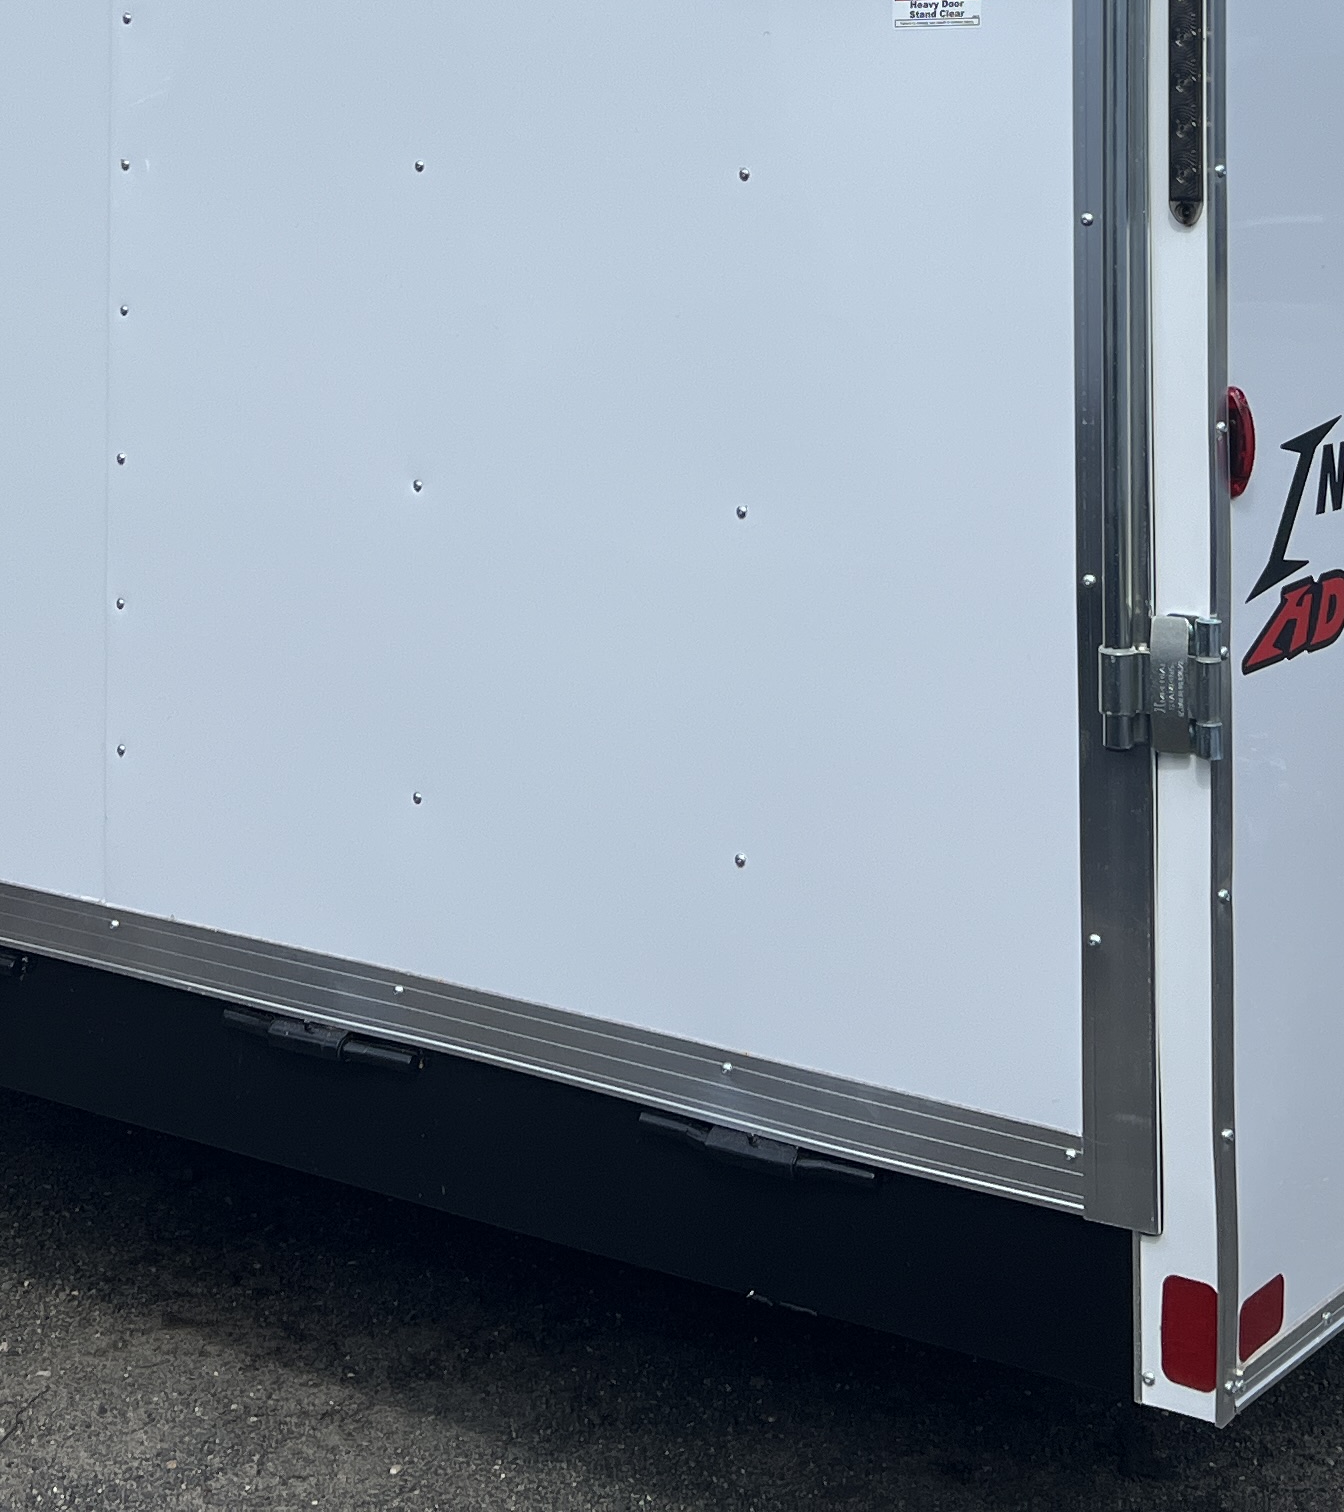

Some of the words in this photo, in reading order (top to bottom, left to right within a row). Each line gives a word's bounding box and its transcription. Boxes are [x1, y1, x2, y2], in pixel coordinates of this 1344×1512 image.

[910, 0, 939, 10] Heavy
[942, 0, 964, 8] Door
[909, 10, 937, 18] Stand
[939, 9, 965, 18] Clear
